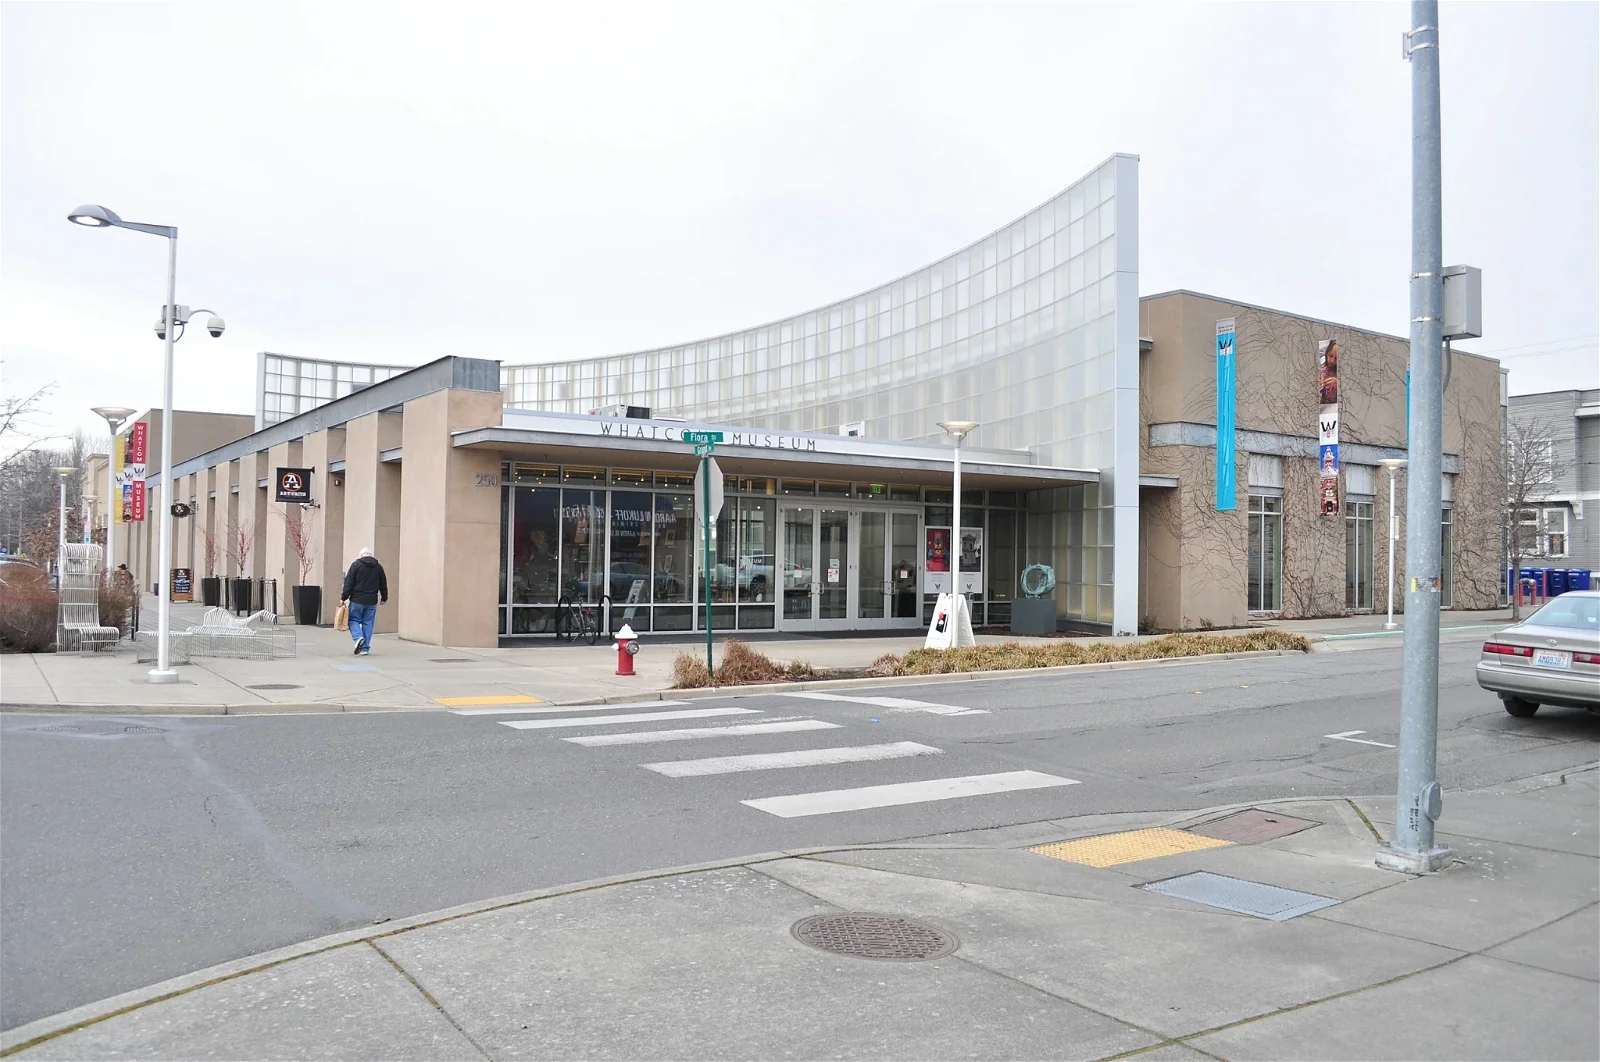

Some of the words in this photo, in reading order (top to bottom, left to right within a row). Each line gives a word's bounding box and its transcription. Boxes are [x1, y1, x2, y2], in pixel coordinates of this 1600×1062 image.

[600, 422, 700, 440] WHATC
[732, 432, 816, 451] MUSEUM
[690, 432, 708, 442] Flora
[475, 472, 498, 488] 250
